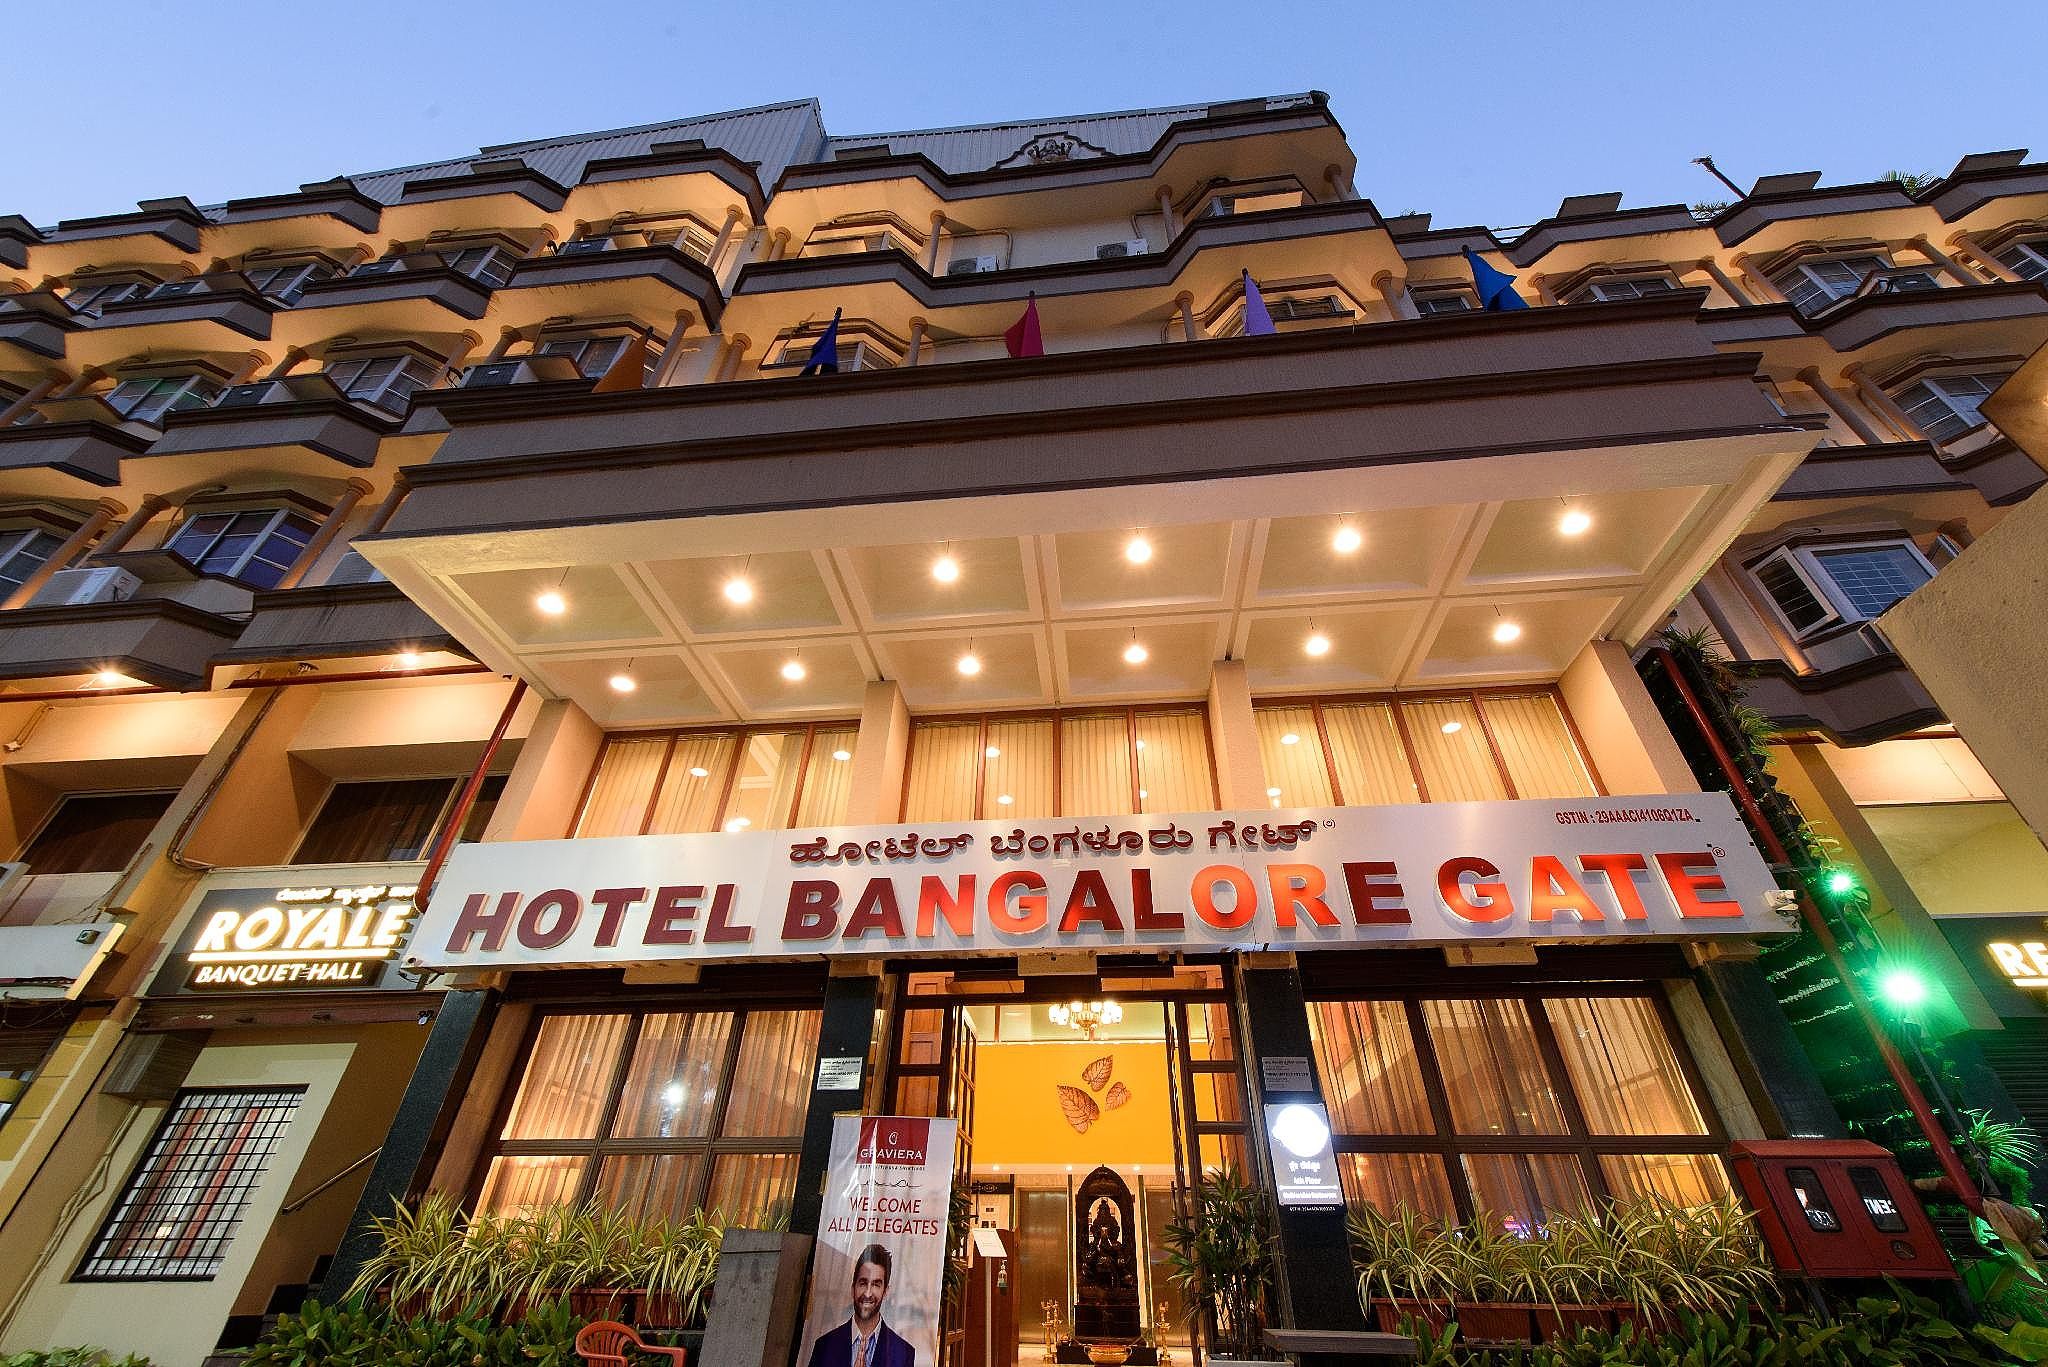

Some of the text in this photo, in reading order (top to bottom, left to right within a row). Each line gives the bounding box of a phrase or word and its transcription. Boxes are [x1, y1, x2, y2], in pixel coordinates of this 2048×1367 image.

[1556, 811, 1590, 825] GSTIN
[789, 819, 1318, 863] ಹೋಟೆಲ್ ಬೆಂಗಳೂರು ಗೇಟ್
[445, 852, 1745, 953] HOTEL BANGALORE GATE
[193, 905, 411, 951] ROYALE
[194, 961, 363, 985] BANQUET HALL
[860, 1148, 923, 1160] GRAVIERA
[828, 1217, 938, 1236] ALL DELEGATES
